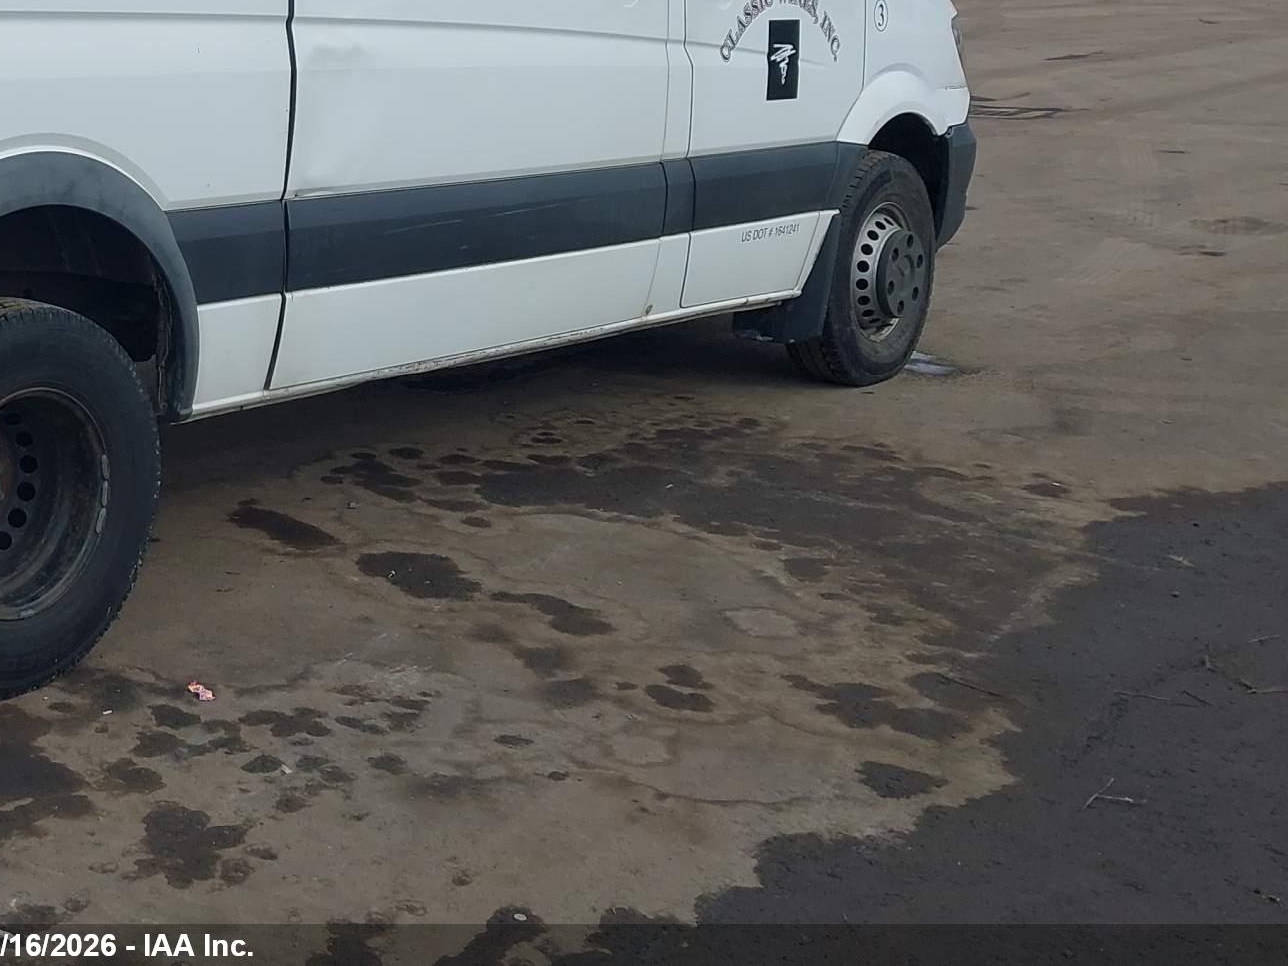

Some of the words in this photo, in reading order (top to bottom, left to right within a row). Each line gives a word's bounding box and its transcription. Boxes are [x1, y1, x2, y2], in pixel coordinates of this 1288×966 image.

[877, 3, 885, 27] 3
[820, 10, 840, 62] INC.
[741, 230, 752, 242] US
[752, 227, 768, 240] DOT
